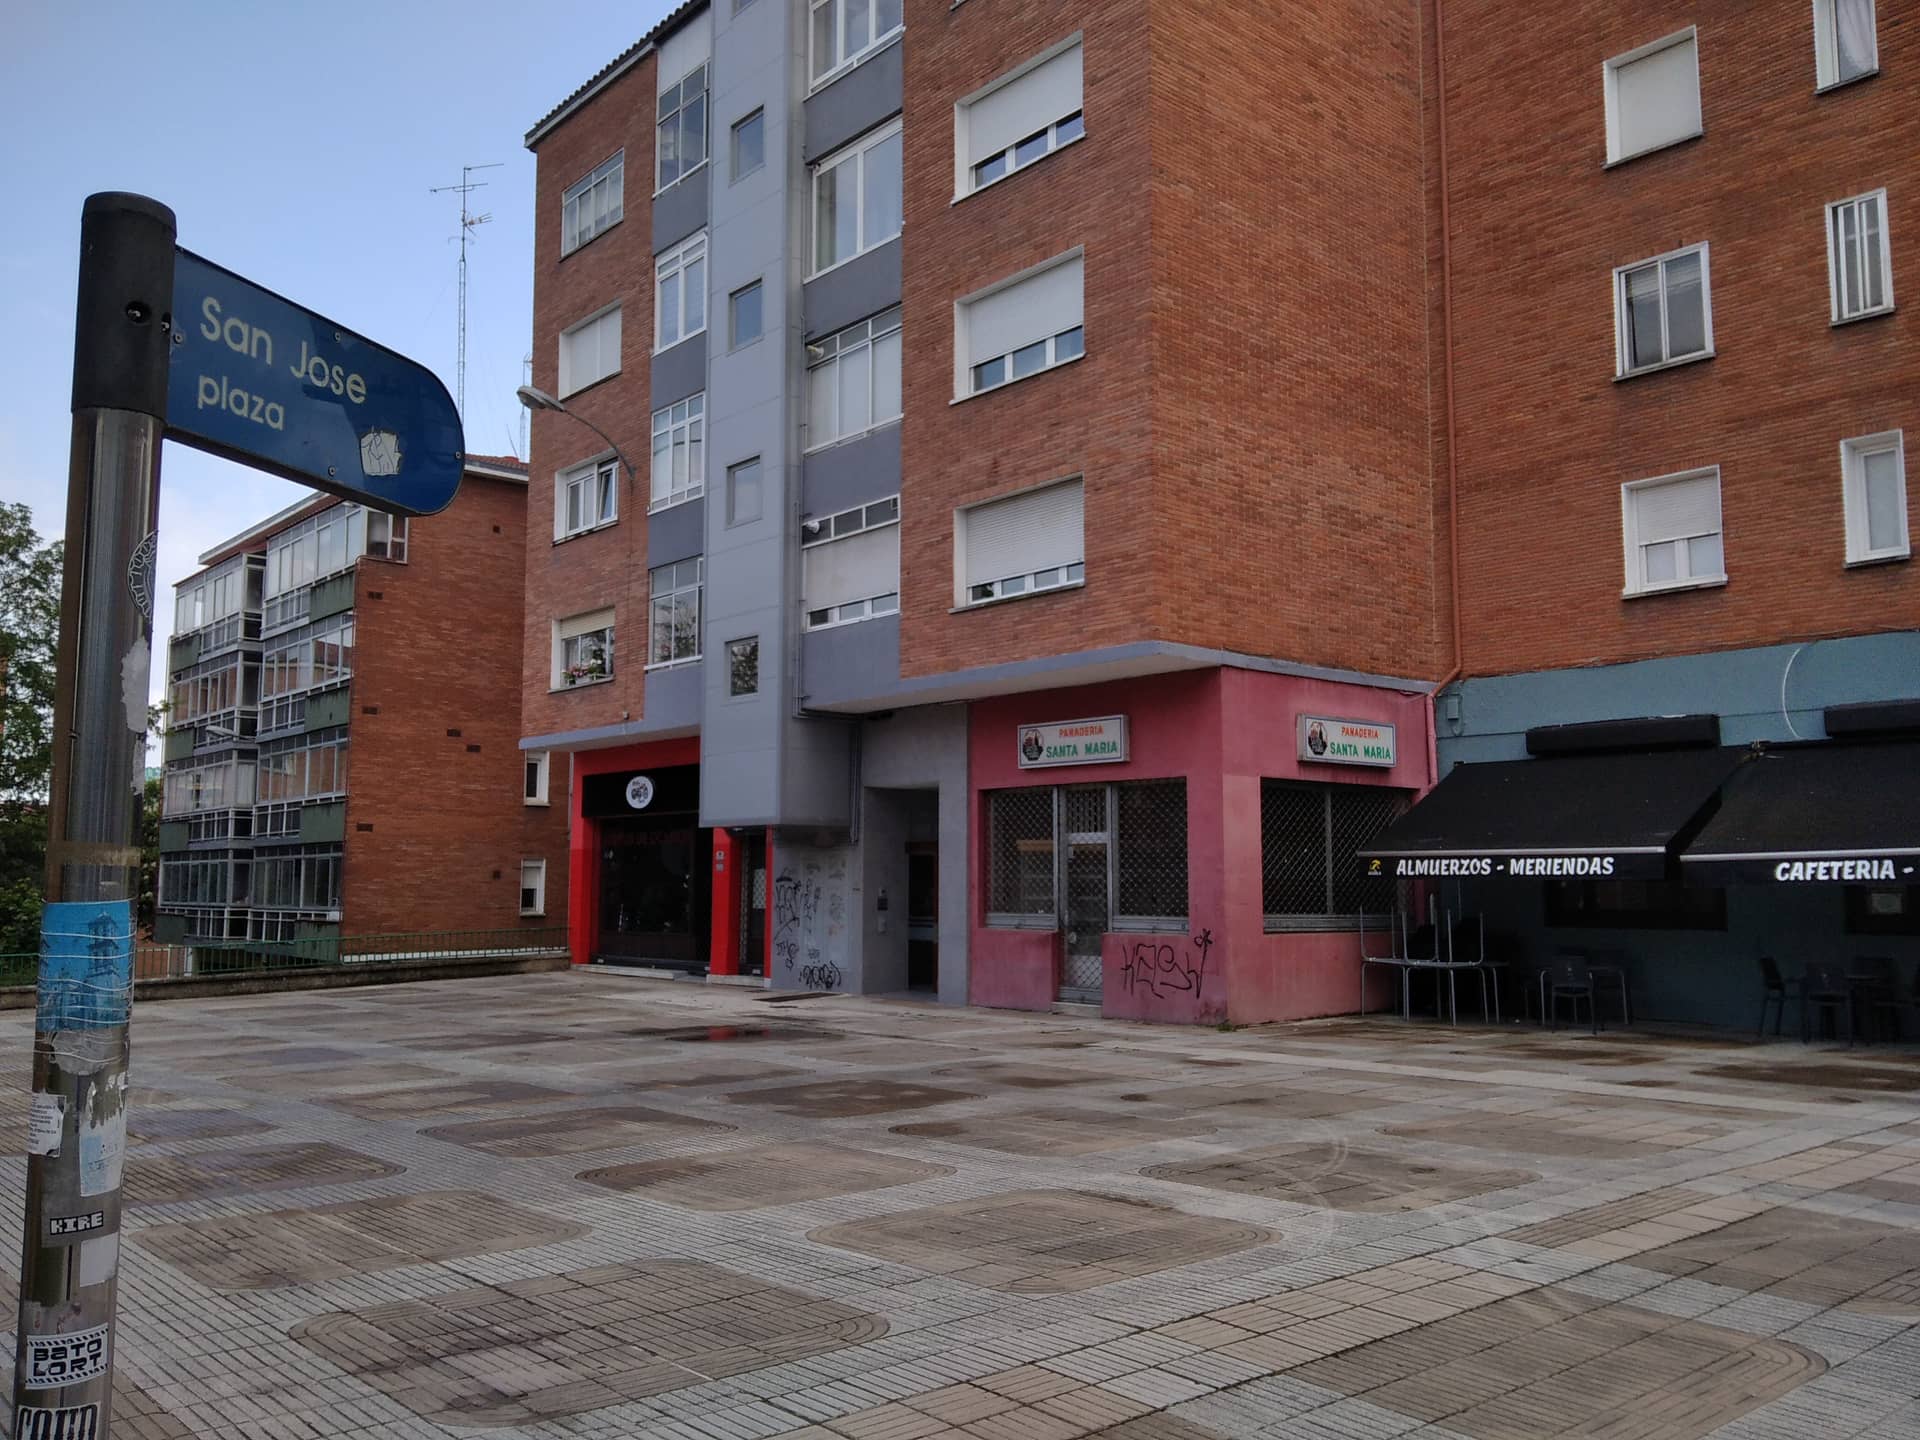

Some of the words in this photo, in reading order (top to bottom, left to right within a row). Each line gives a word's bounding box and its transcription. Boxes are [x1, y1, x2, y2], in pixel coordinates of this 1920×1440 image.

[199, 296, 273, 366] San
[290, 341, 367, 404] Jose
[197, 375, 285, 430] plaza
[1058, 725, 1105, 738] PANADERIA
[1341, 726, 1380, 739] PANADERIA
[1046, 744, 1078, 758] SANTA
[1085, 740, 1118, 755] MARIA
[1330, 742, 1359, 757] SANTA
[1363, 745, 1392, 760] MARIA
[1396, 858, 1492, 876] ALMUERZOS
[1509, 857, 1615, 876] MERIENDAS
[1775, 859, 1896, 881] CAFETERIA
